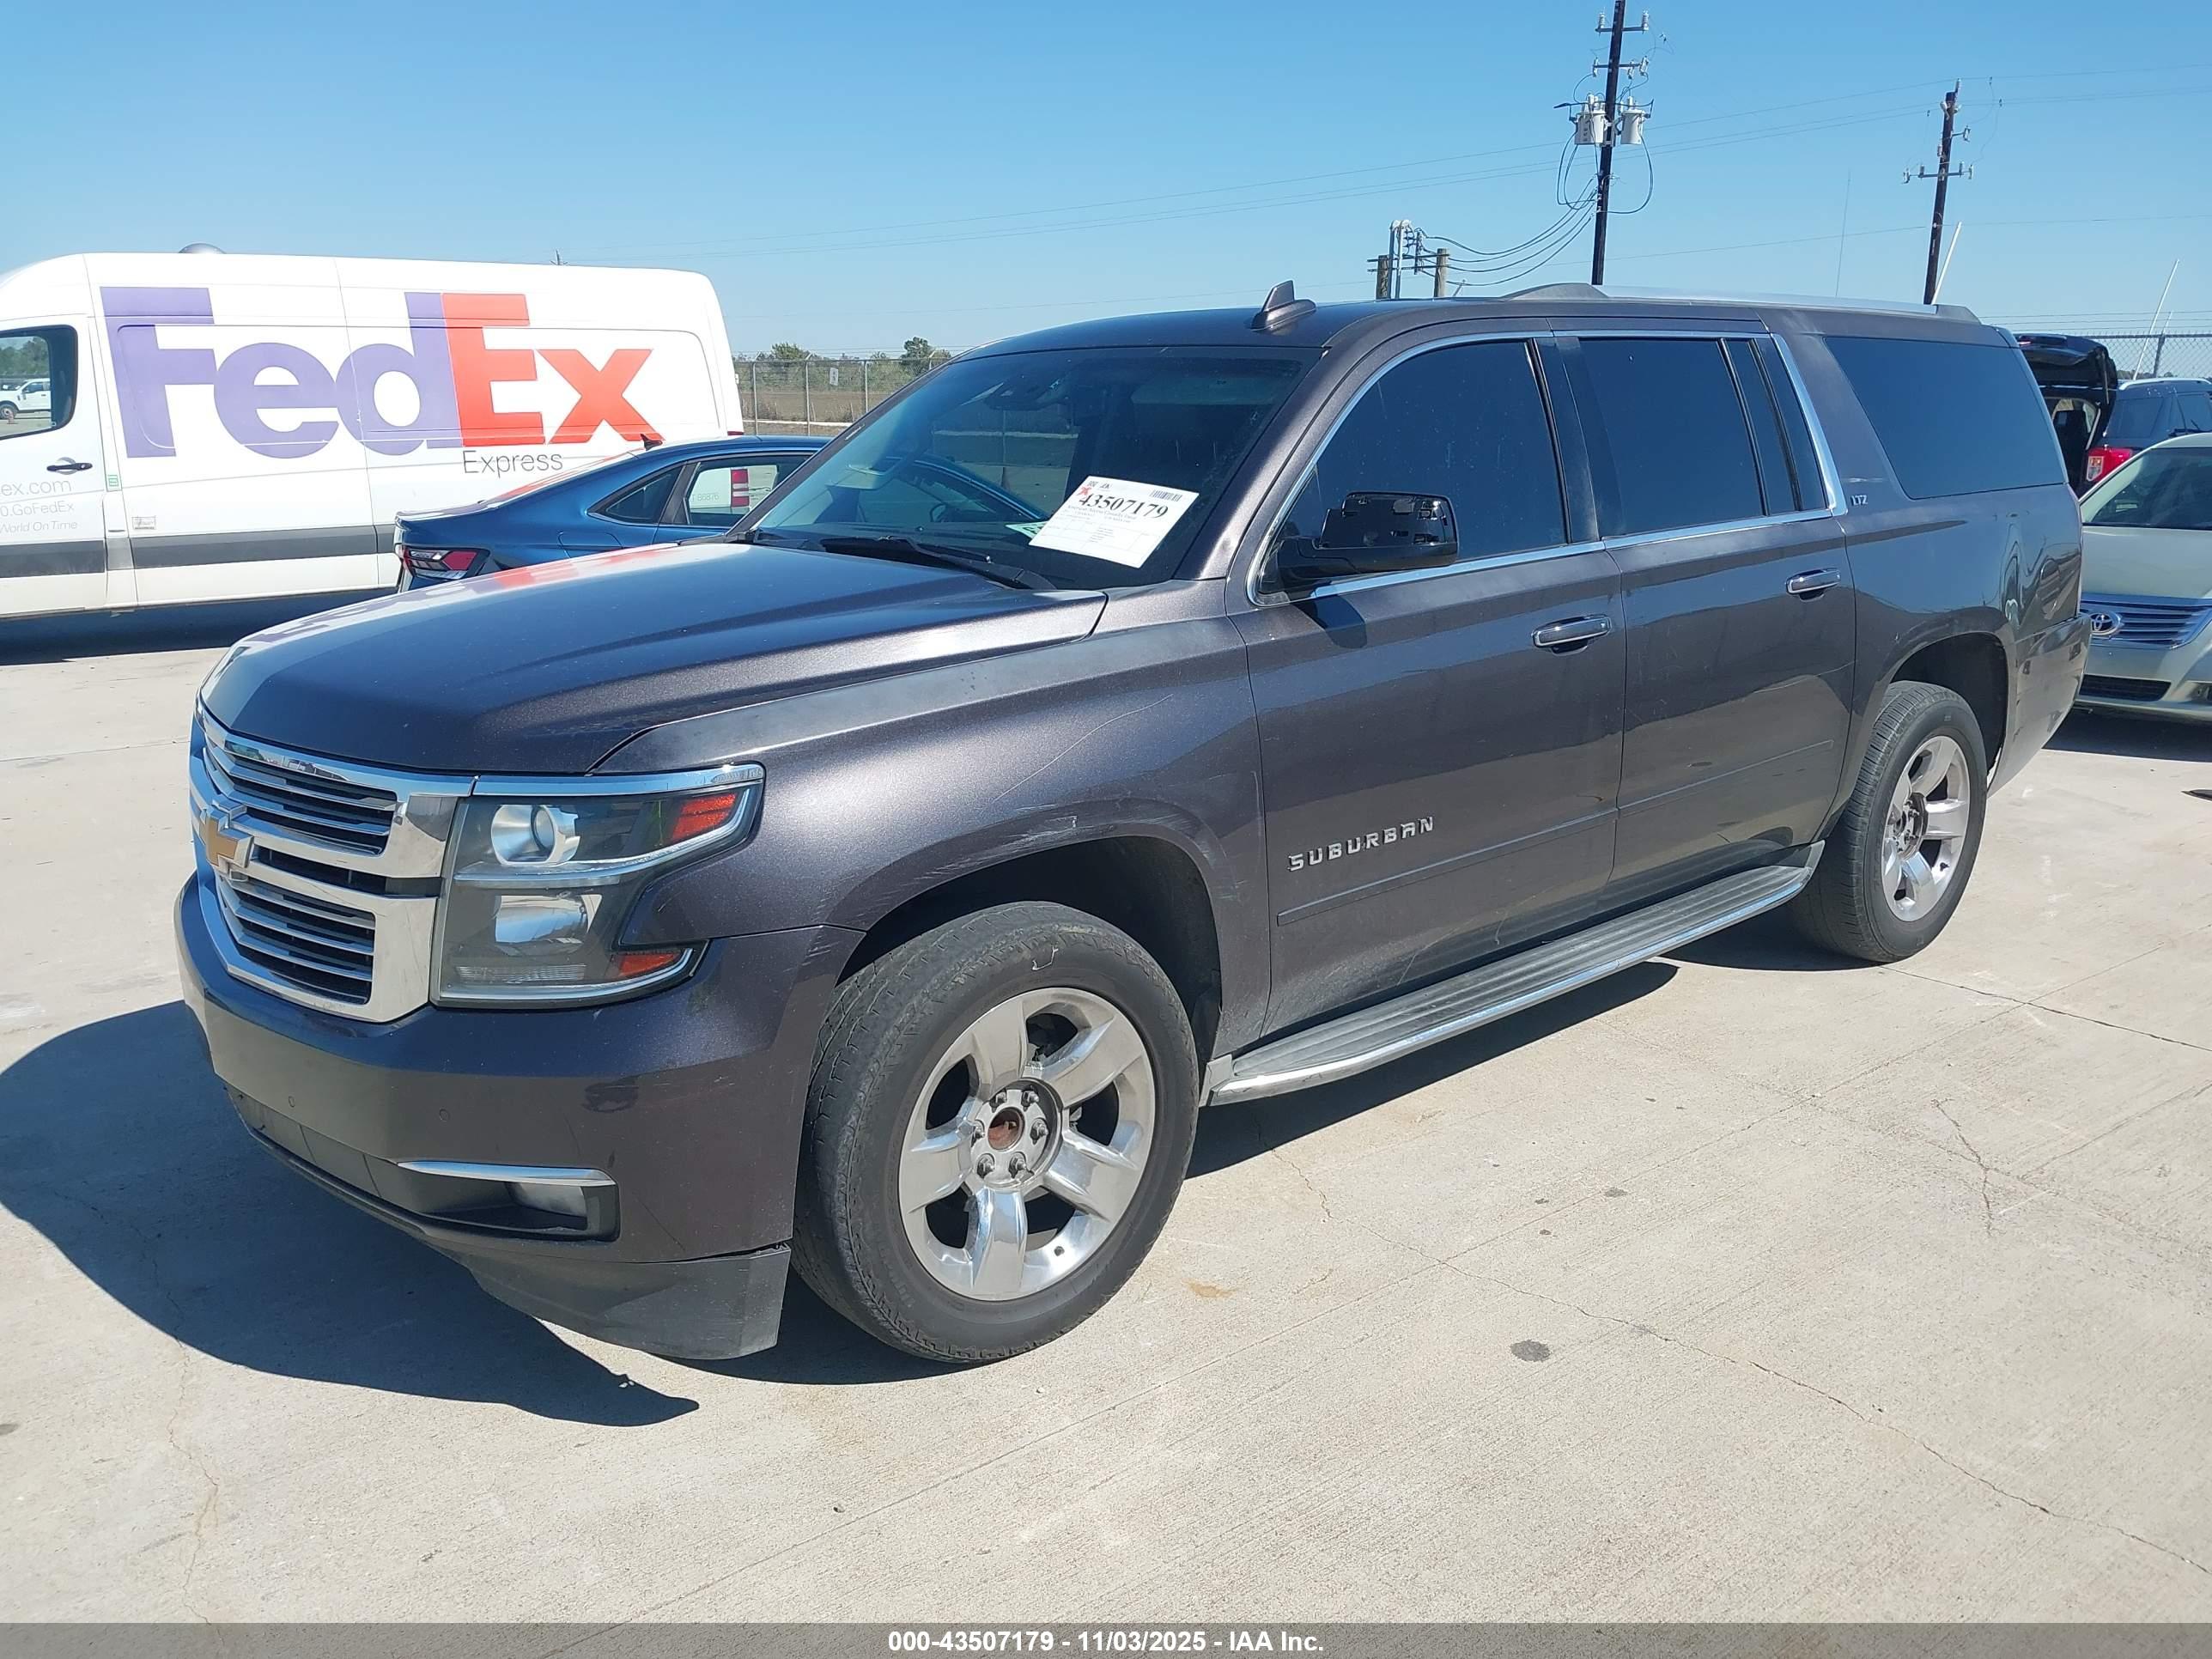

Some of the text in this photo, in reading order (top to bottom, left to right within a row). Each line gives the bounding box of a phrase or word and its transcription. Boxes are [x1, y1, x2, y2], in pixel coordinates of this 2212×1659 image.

[100, 286, 665, 459] FedEx
[464, 450, 563, 477] Express
[1079, 493, 1169, 519] 43507179
[1850, 494, 1869, 507] LTZ
[33, 521, 49, 532] On
[51, 520, 77, 530] Time
[1287, 816, 1434, 872] SUBURBAN
